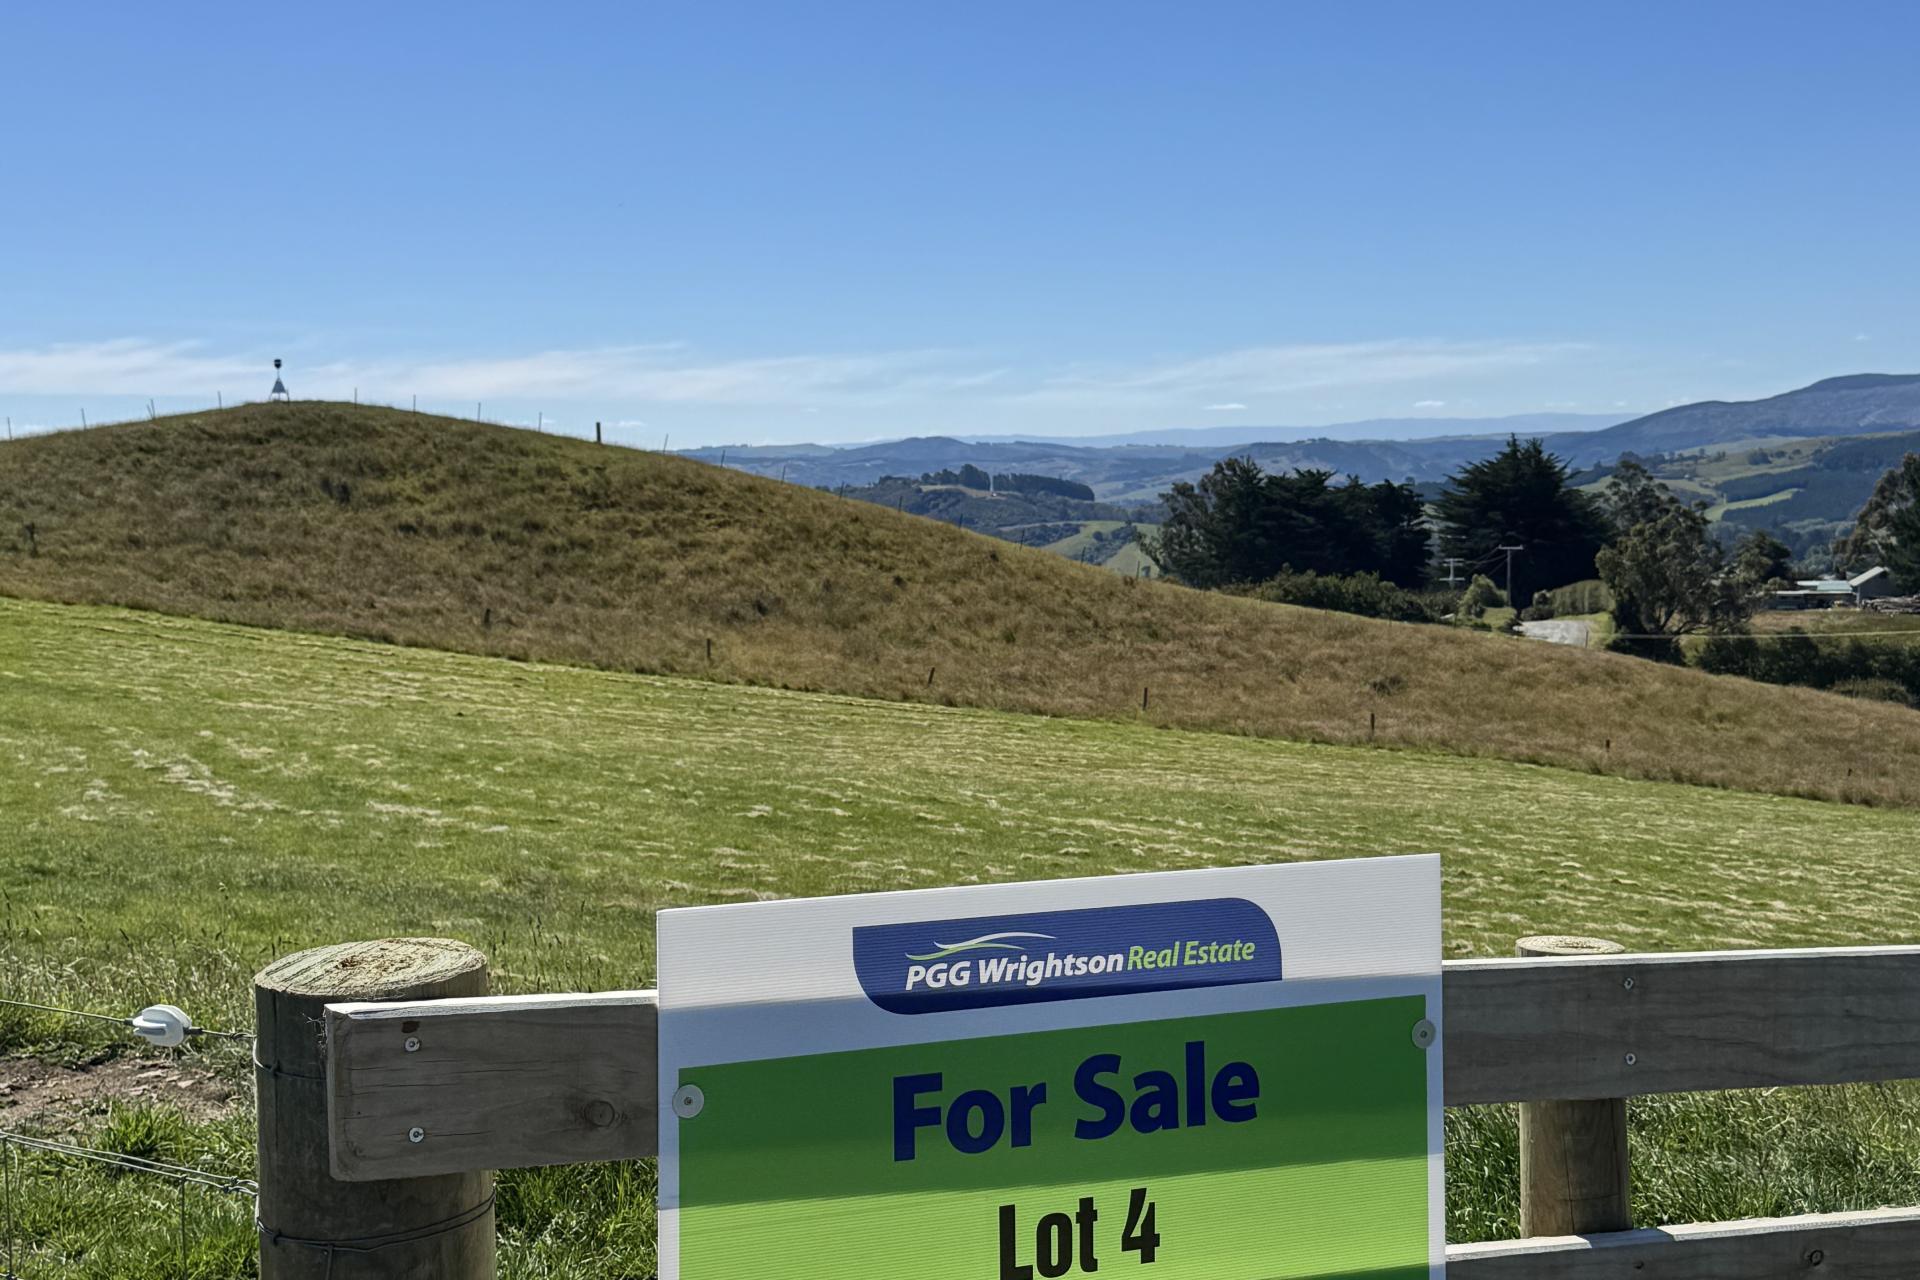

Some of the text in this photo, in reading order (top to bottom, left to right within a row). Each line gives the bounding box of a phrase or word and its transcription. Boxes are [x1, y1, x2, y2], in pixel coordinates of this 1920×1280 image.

[905, 939, 1256, 990] PGG Wrightson Real Estate
[893, 1041, 1260, 1162] For Sale
[998, 1188, 1160, 1280] Lot 4
